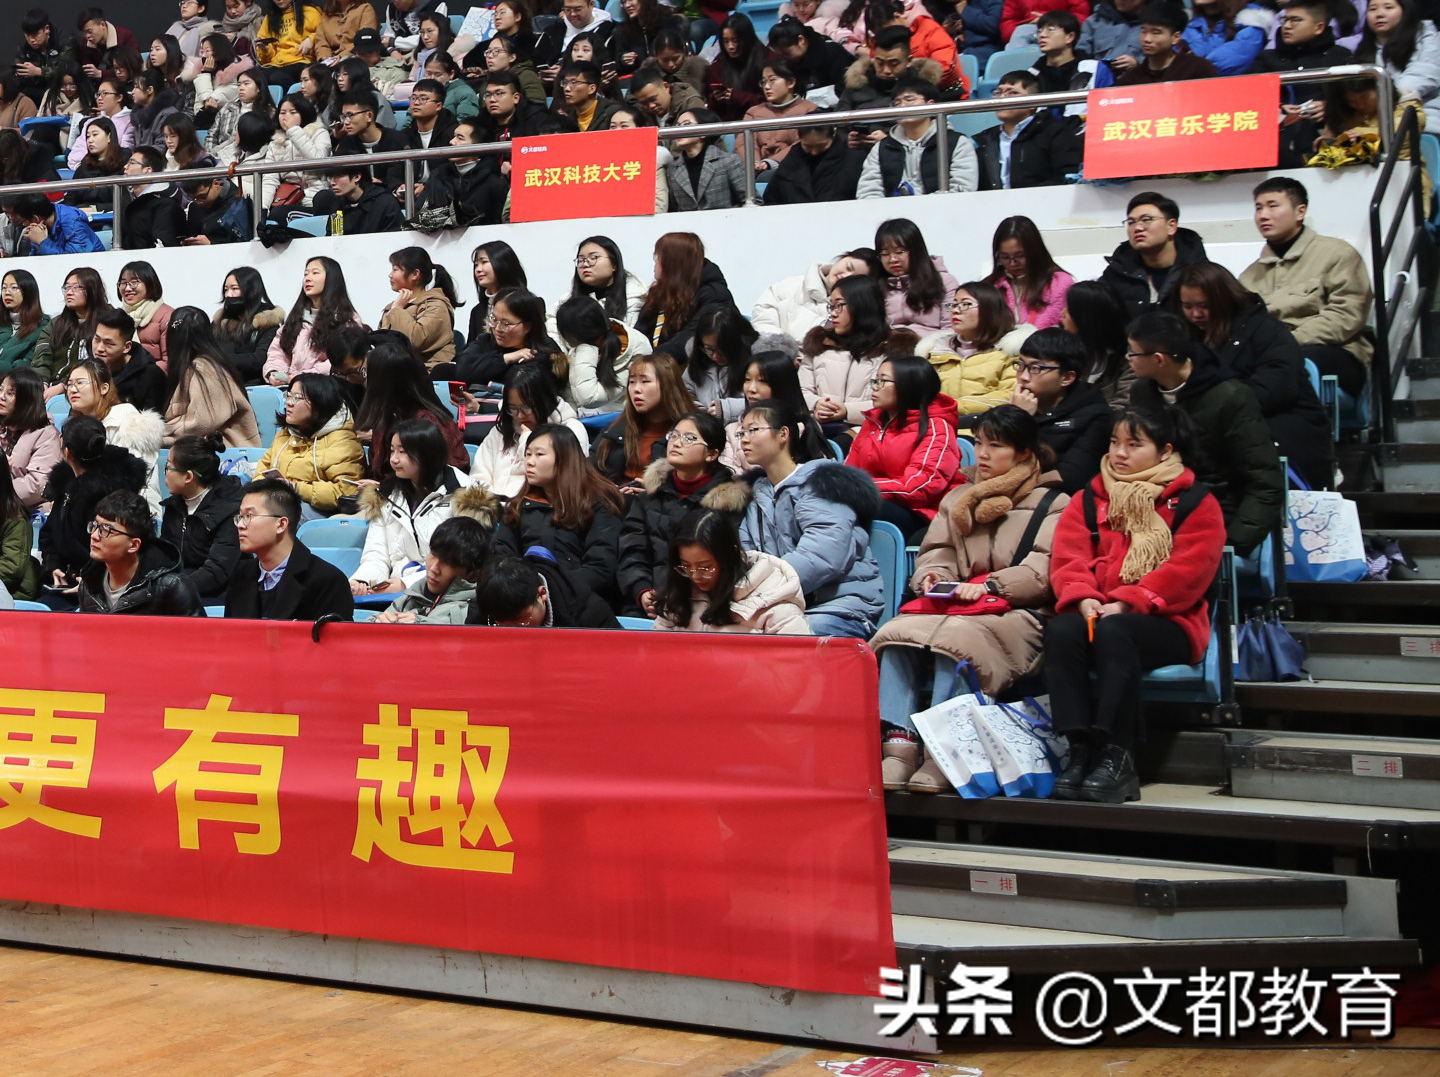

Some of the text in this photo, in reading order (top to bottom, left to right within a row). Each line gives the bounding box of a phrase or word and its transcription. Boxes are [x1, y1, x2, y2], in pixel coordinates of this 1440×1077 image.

[1103, 110, 1260, 141] 武汉音乐学院
[524, 161, 641, 187] 武汉科技大学
